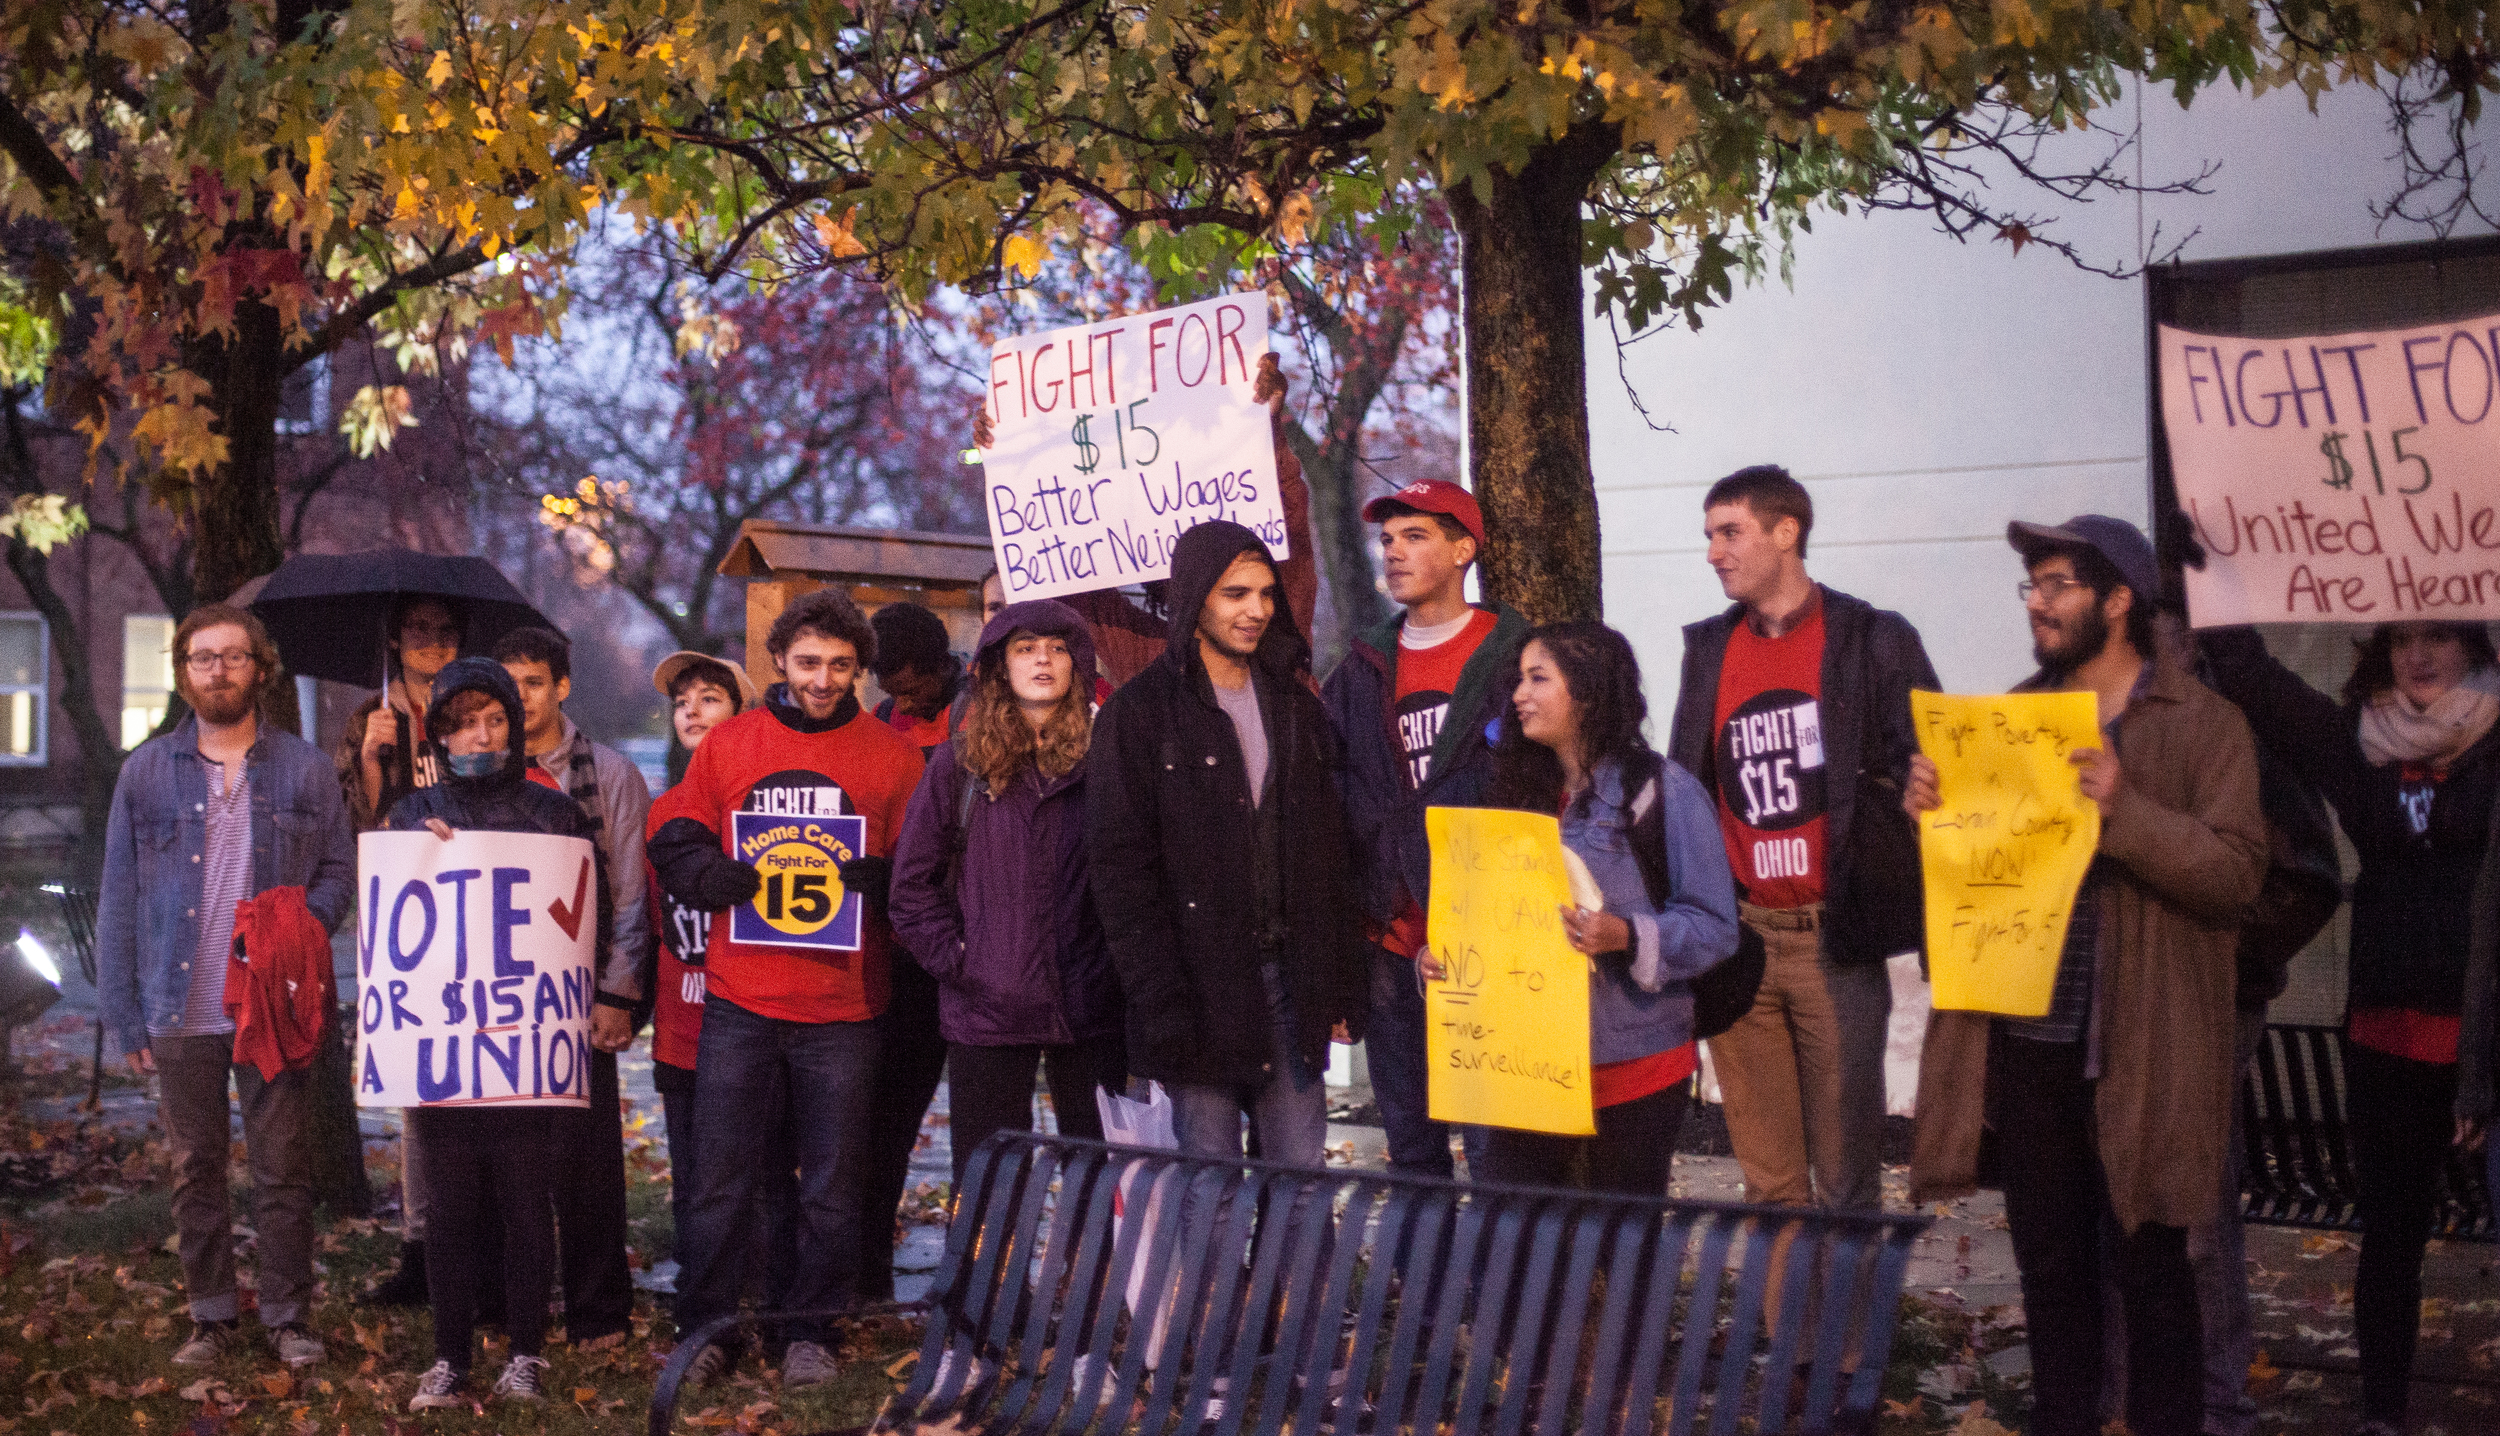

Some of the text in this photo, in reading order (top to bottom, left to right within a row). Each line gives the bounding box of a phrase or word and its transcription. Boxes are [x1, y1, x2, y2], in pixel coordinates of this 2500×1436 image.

[991, 304, 1248, 424] FIGHT FOR
[2183, 343, 2377, 429] FIGHT
[1071, 397, 1160, 476] $15
[2319, 426, 2433, 496] $15
[992, 460, 1258, 537] Better Wages
[2189, 489, 2500, 557] United We
[1003, 533, 1104, 592] Better
[2286, 555, 2500, 614] Are Hear
[1729, 707, 1794, 759] FIGHT
[1739, 757, 1799, 826] $15
[741, 823, 854, 864] Home Care
[766, 854, 830, 870] Fight For
[1753, 837, 1810, 880] OHIO
[358, 867, 535, 981] VOTE
[766, 871, 832, 925] 15
[1442, 941, 1546, 993] NO to
[442, 977, 525, 1029] $15
[362, 1042, 385, 1095] A
